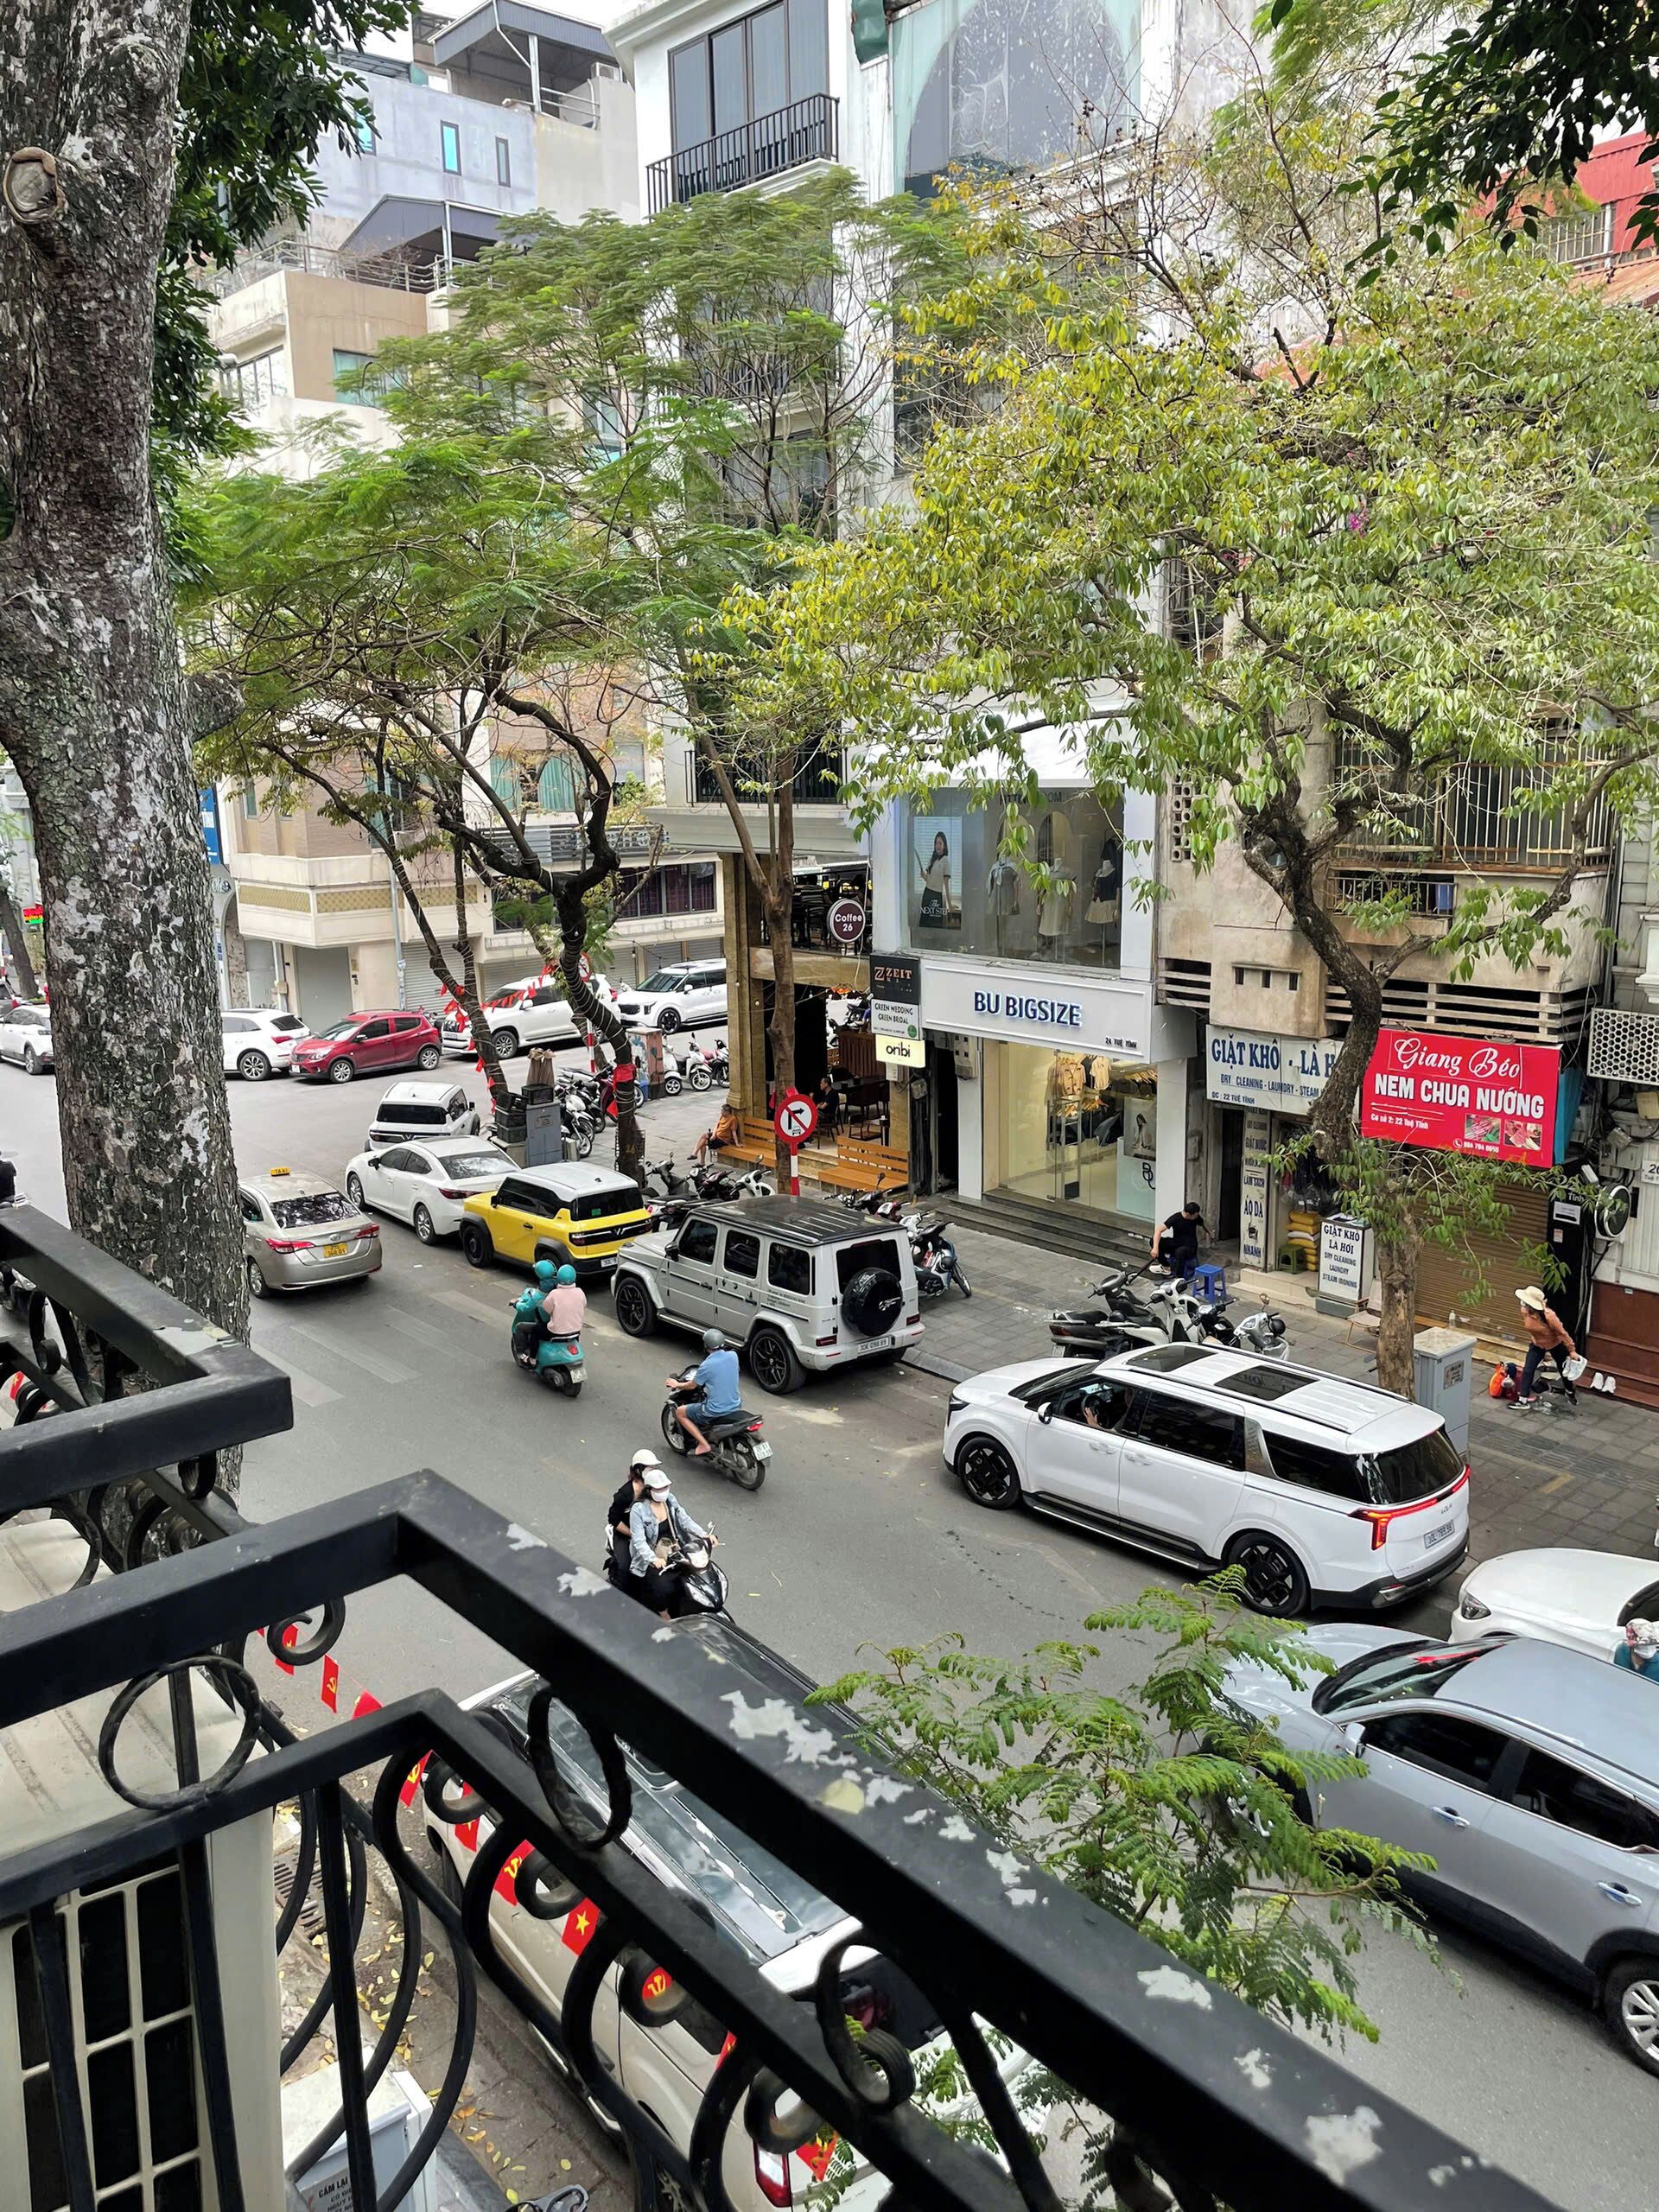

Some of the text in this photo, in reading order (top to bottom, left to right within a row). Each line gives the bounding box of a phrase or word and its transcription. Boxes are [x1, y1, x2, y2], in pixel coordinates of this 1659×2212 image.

[835, 913, 862, 922] Coffee
[842, 923, 853, 931] 26
[886, 967, 912, 979] ZEIT
[874, 1002, 913, 1015] GREEN WEDDING
[974, 991, 1081, 1027] BU BIGSIZE
[893, 1015, 908, 1024] BRIDAL
[886, 1042, 911, 1058] oribi
[1211, 1033, 1245, 1070] GIẶT
[1249, 1039, 1280, 1071] KHÔ
[1300, 1044, 1320, 1077] LÀ
[1395, 1038, 1521, 1078] Giang Béo
[1220, 1074, 1231, 1084] DRY
[1236, 1076, 1263, 1090] CLEANING
[1268, 1080, 1294, 1094] LAUNDRY
[1300, 1086, 1319, 1097] STEAM
[1375, 1073, 1544, 1119] NEM CHUA NƯỚNG
[1243, 1195, 1263, 1218] ÁO DA
[1344, 1229, 1360, 1242] KHÔ
[1334, 1254, 1356, 1267] CLEANING
[1329, 1264, 1349, 1274] LAUNDRY
[1323, 1273, 1338, 1283] STEAM
